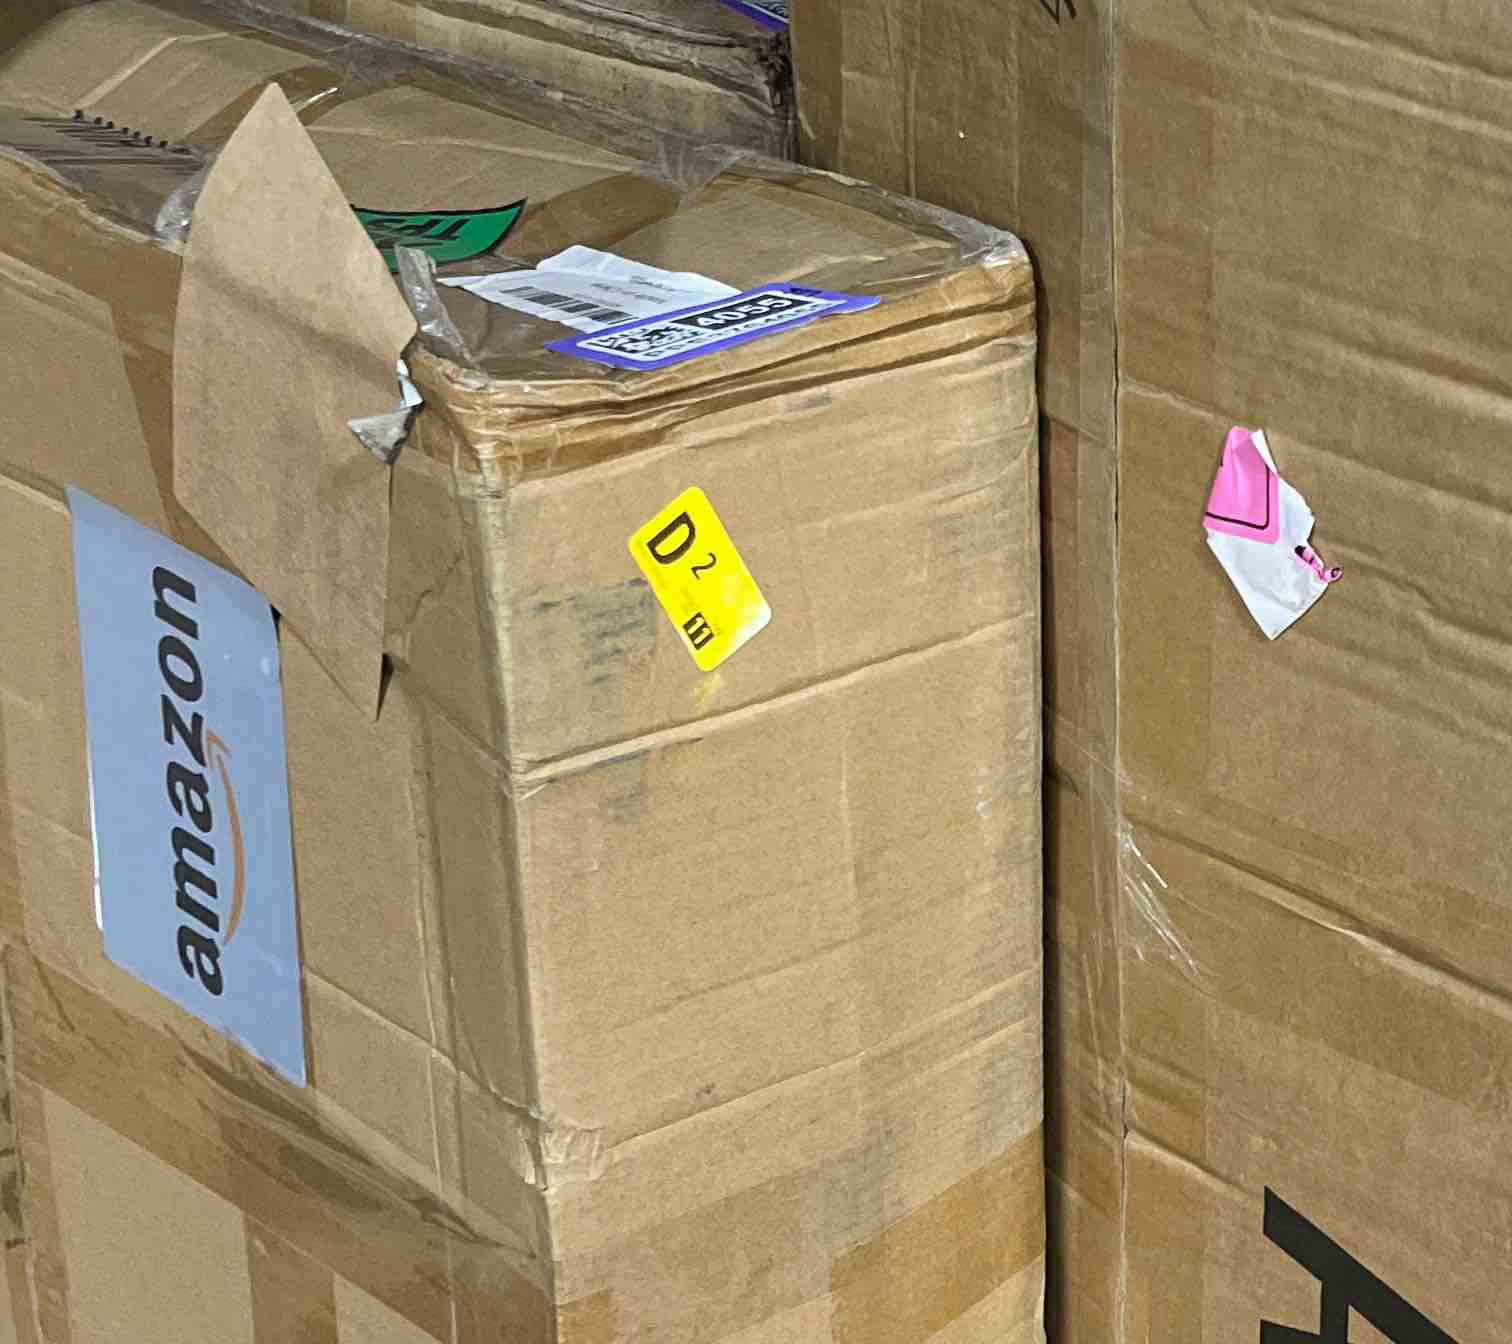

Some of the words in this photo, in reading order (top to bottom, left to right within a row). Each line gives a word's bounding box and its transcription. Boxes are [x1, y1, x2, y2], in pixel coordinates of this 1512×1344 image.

[694, 296, 791, 331] 4055
[646, 511, 697, 568] D
[151, 564, 225, 999] amazon
